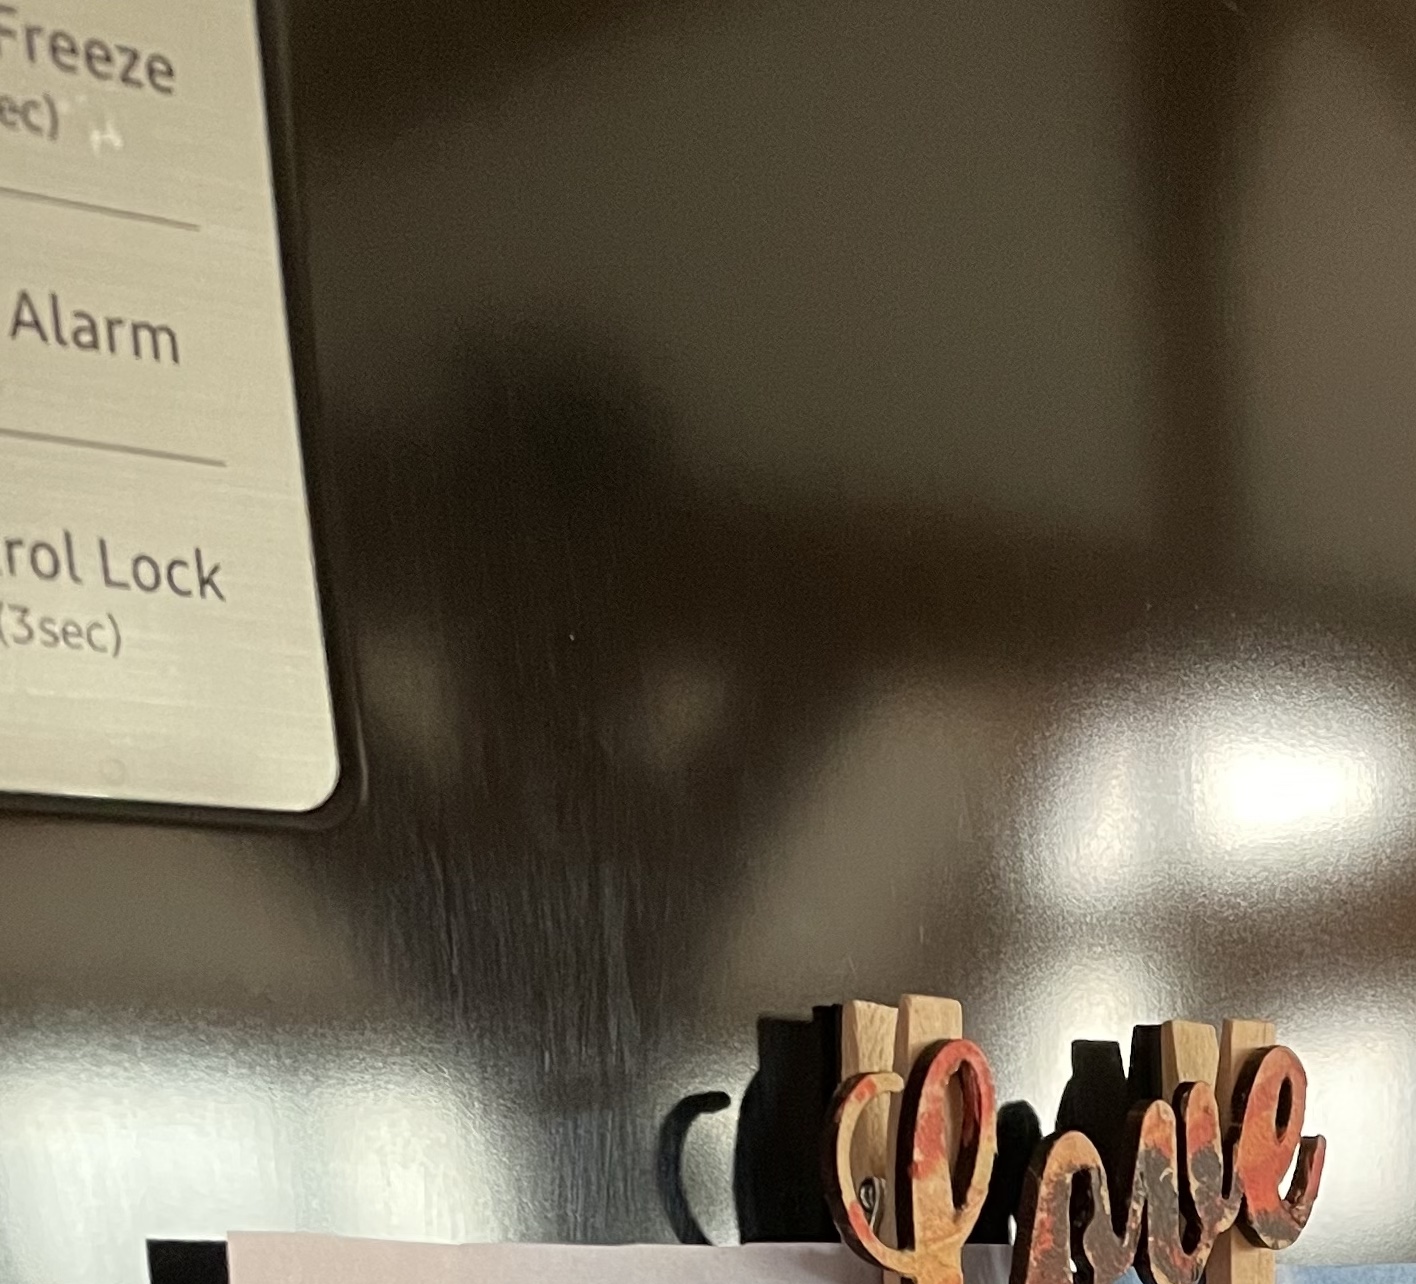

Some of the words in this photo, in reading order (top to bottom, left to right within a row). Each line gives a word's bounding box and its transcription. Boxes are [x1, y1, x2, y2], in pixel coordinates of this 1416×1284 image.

[9, 287, 181, 366] Alarm
[0, 528, 84, 586] rol
[97, 536, 227, 602] Lock
[0, 601, 122, 659] (3sec)
